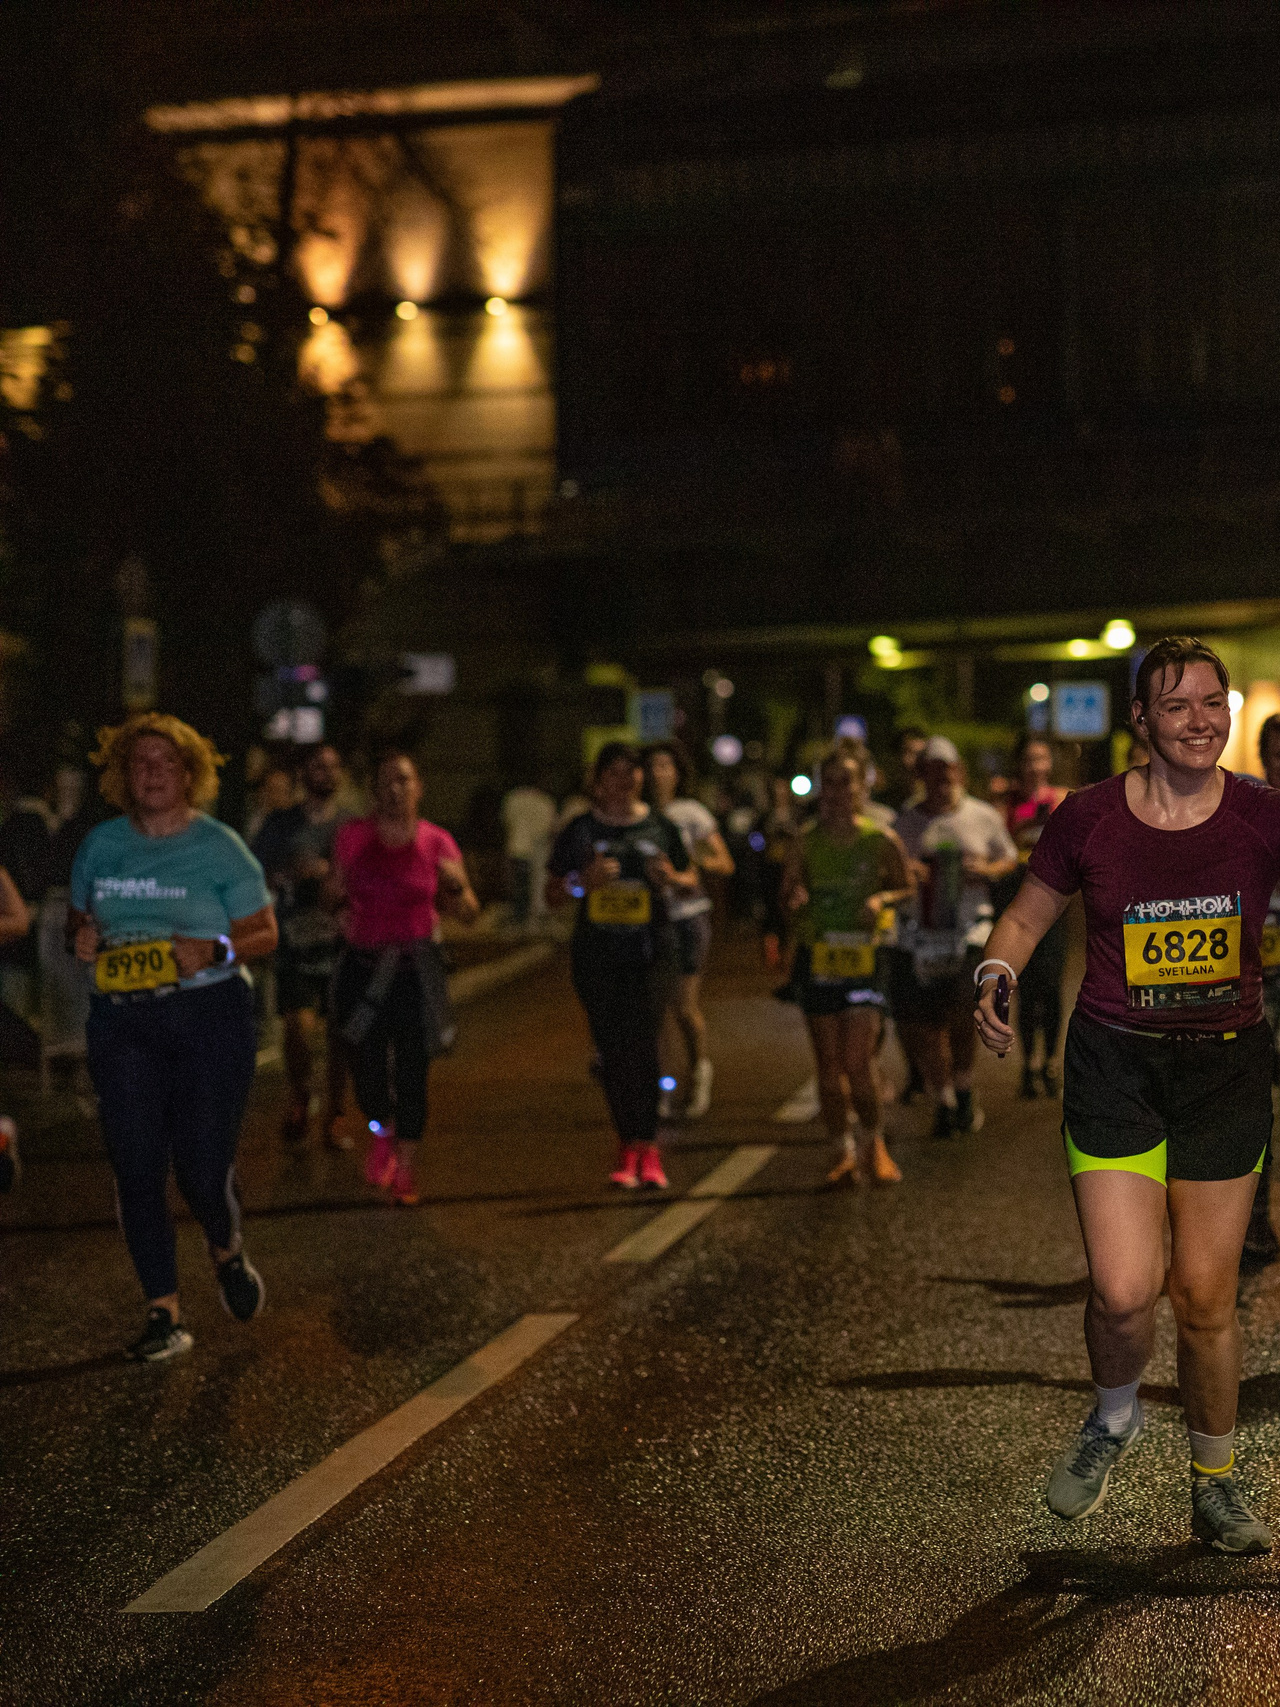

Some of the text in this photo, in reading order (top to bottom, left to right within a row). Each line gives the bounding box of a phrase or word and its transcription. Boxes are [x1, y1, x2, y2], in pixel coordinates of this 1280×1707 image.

[1142, 928, 1229, 965] 6828
[106, 948, 163, 978] 5990
[1158, 965, 1215, 977] SVETLANA
